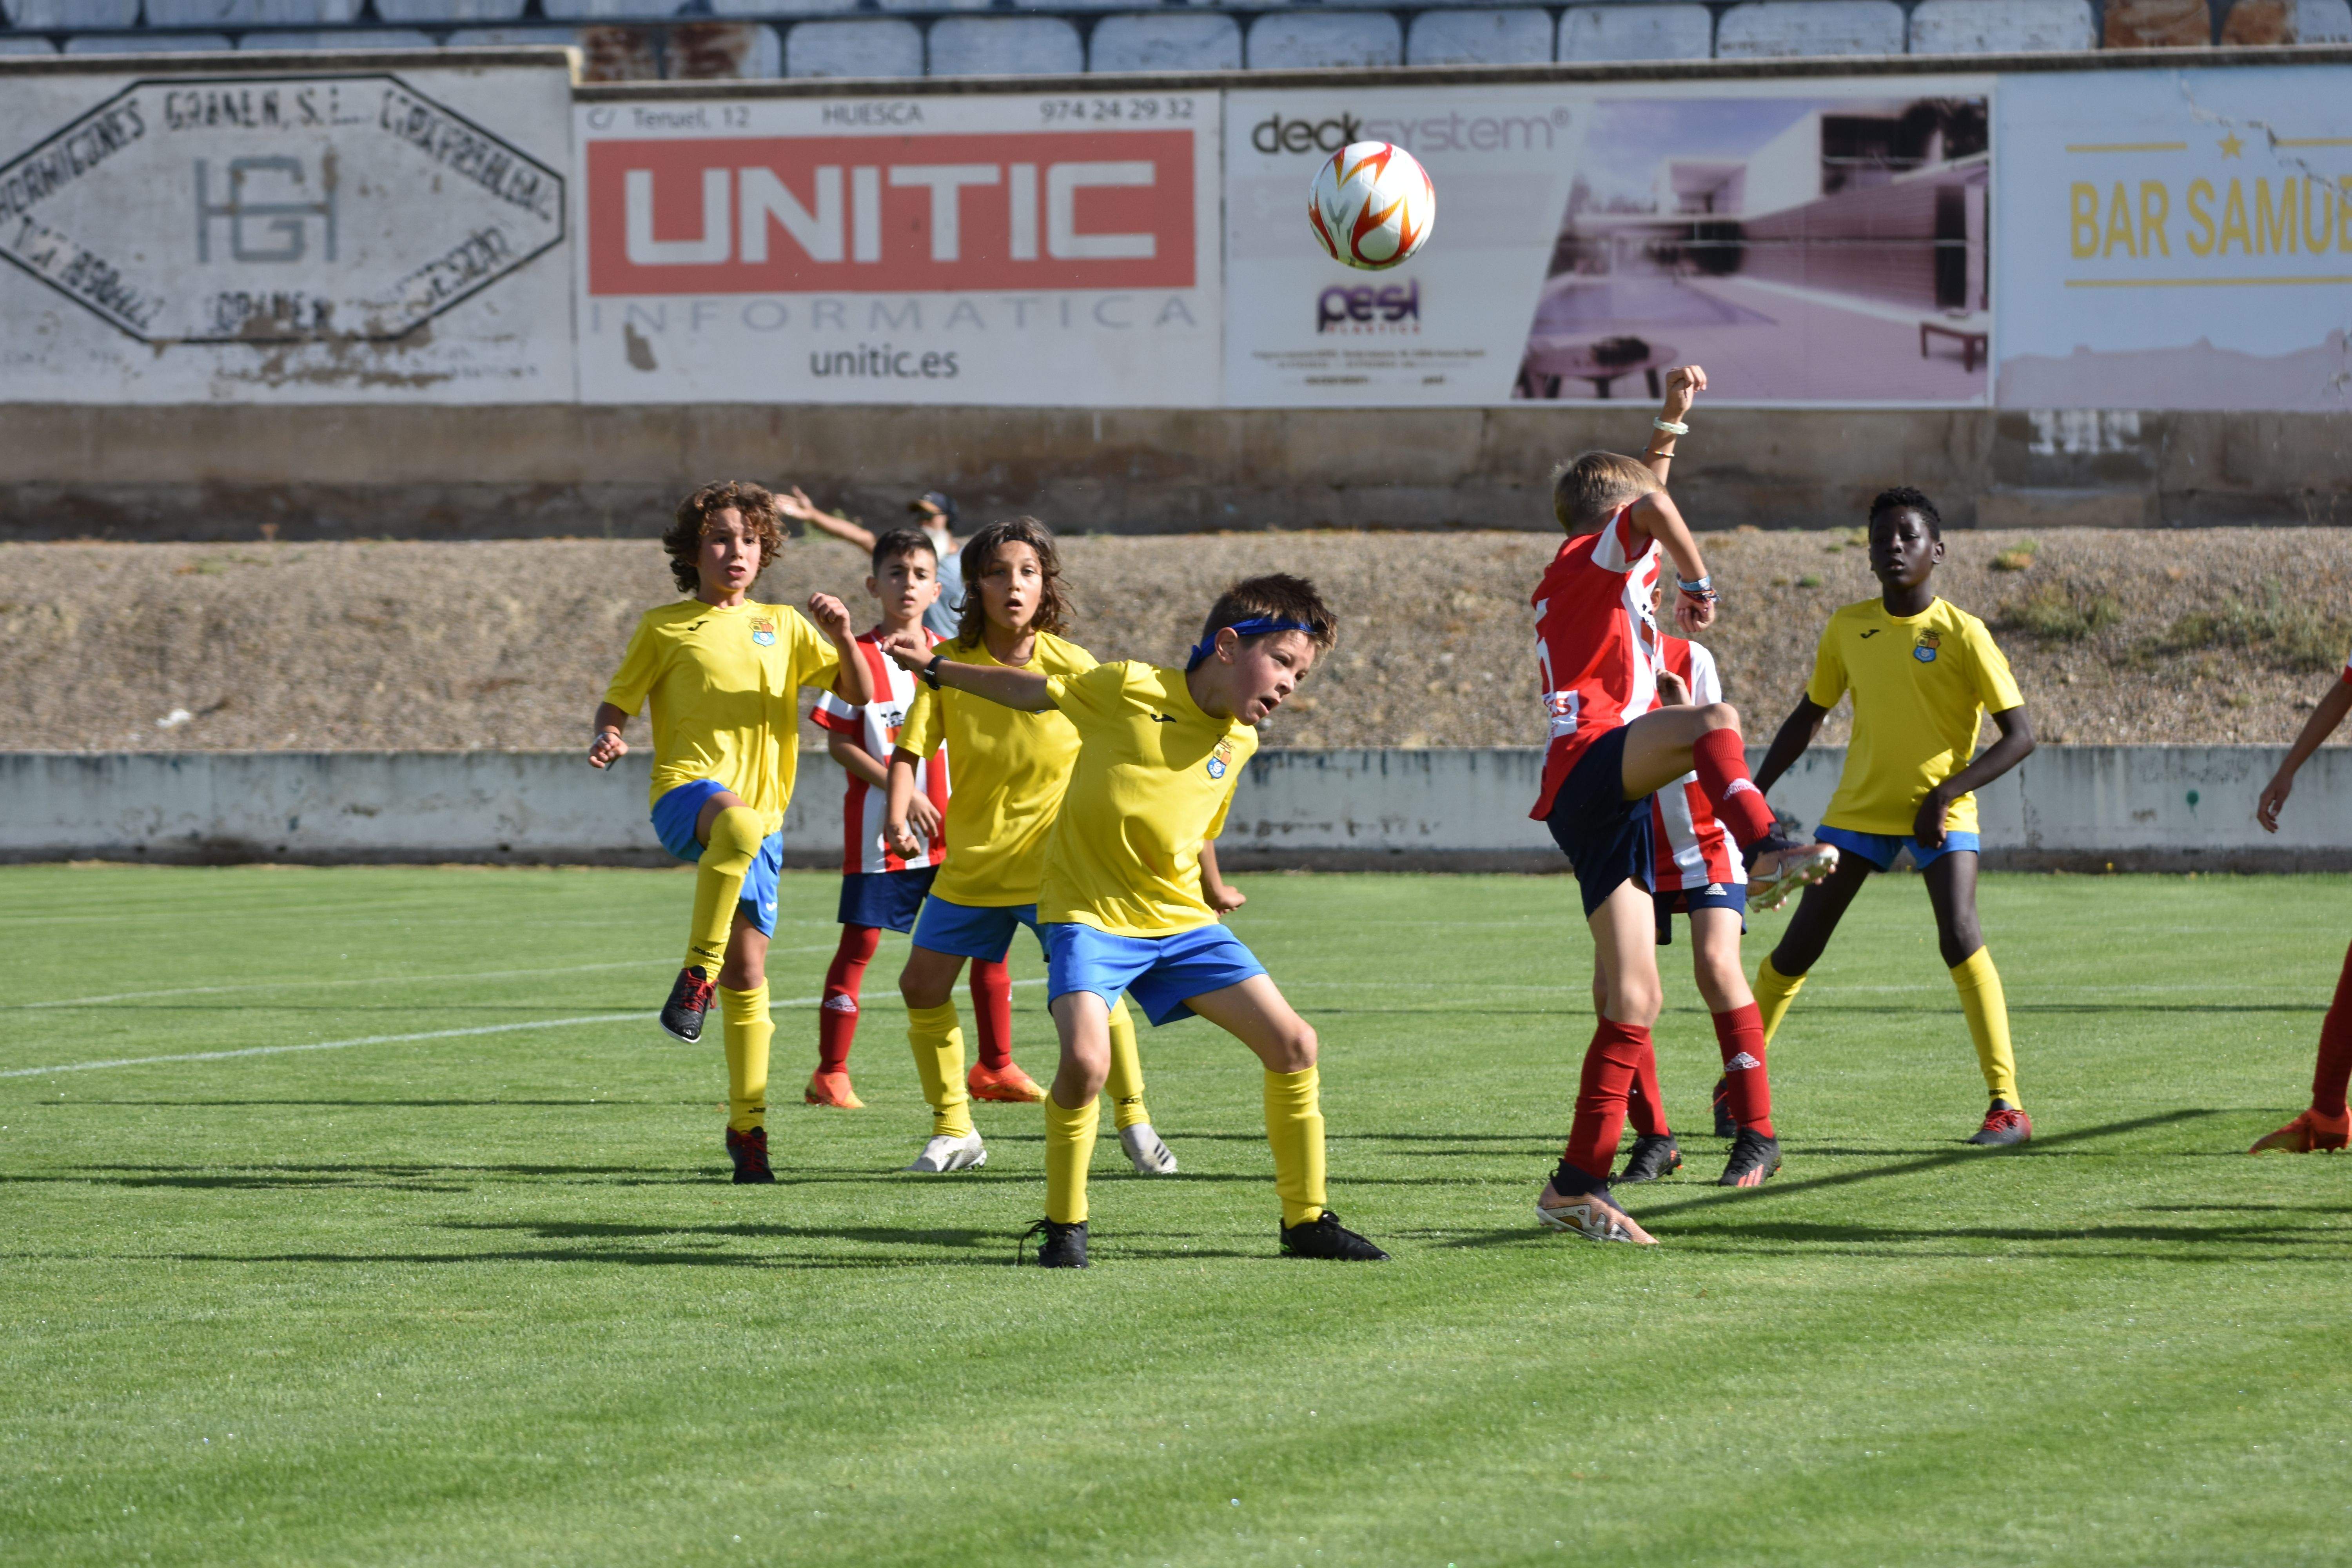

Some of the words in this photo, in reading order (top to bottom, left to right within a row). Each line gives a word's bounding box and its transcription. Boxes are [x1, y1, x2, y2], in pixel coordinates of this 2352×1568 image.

[586, 106, 616, 131] C/
[723, 106, 750, 128] 12
[822, 102, 924, 126] HUESCA
[1040, 100, 1085, 124] 974
[1092, 98, 1122, 122] 24
[1128, 97, 1160, 121] 29
[1165, 97, 1195, 119] 32
[623, 160, 1158, 266] UNITIC
[2071, 180, 2171, 259] BAR
[591, 295, 1198, 334] INFORMATICA
[810, 343, 959, 378] unitic.es
